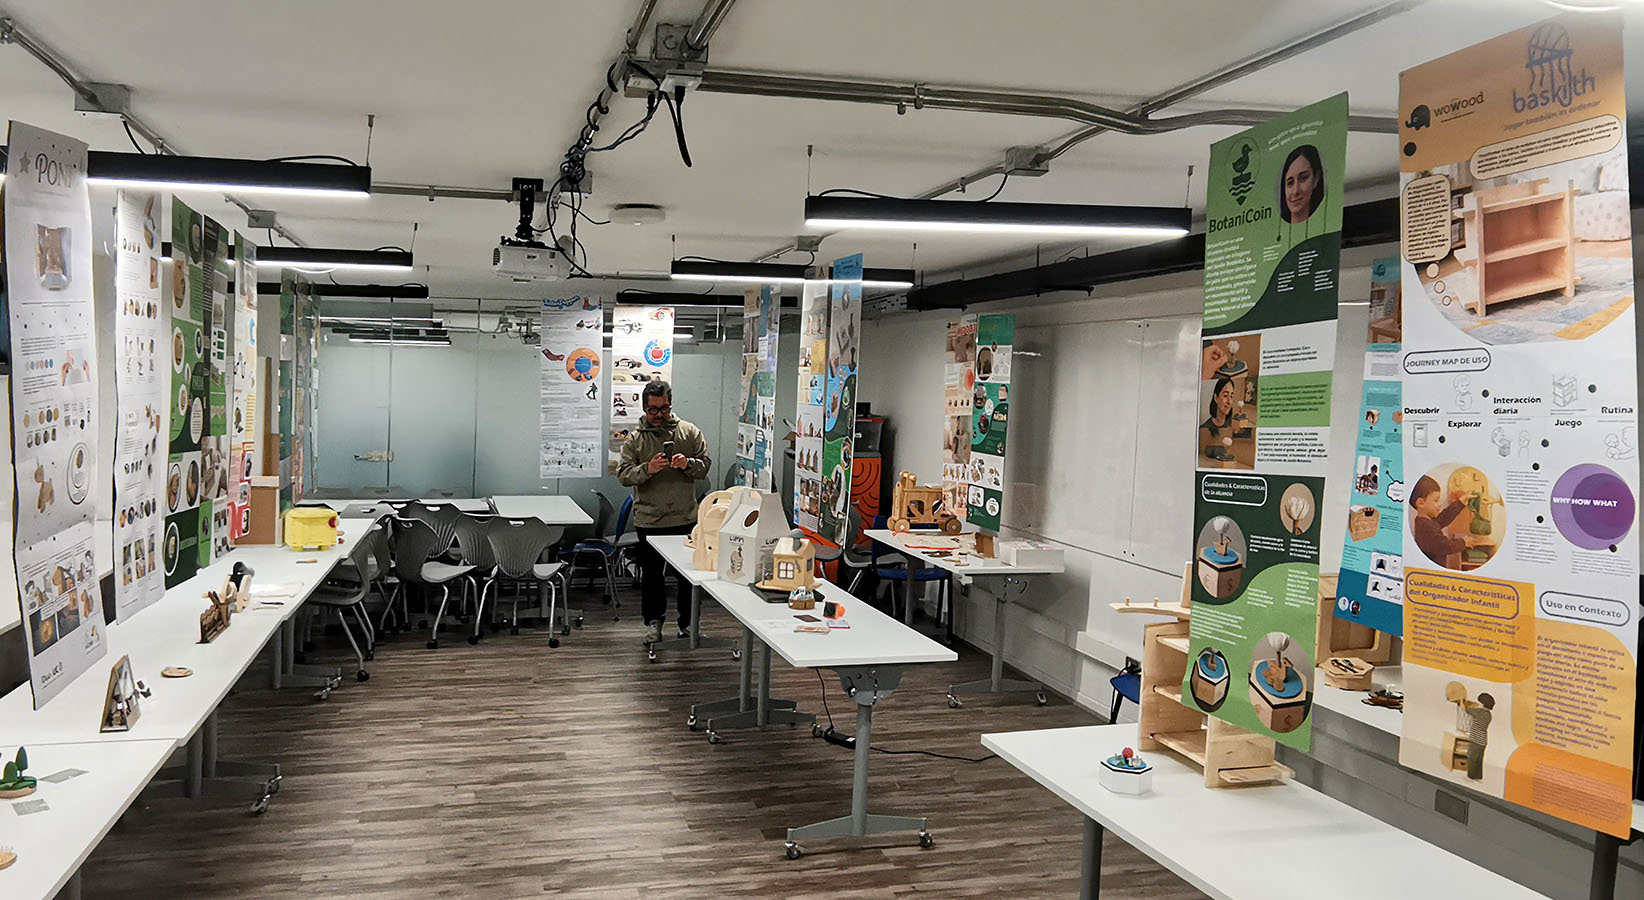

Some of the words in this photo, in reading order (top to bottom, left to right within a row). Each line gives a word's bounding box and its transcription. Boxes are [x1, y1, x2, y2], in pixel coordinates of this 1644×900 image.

[1433, 91, 1485, 117] wowood
[1209, 207, 1272, 233] BotaniCoin
[1406, 359, 1441, 368] JOURNEY
[1472, 356, 1488, 364] USO
[1494, 396, 1542, 405] Interacción
[1404, 407, 1440, 415] Descubrir
[1601, 405, 1634, 415] Rutina
[1494, 407, 1519, 415] diaria
[1448, 420, 1482, 429] Explorar
[1555, 418, 1583, 428] Juego
[1553, 496, 1570, 504] WHY
[1571, 497, 1592, 506] HOW
[1593, 499, 1618, 508] WHAT
[1408, 579, 1450, 591] Cualidades
[1421, 590, 1469, 603] Organizador
[1545, 600, 1563, 610] Uso
[1564, 604, 1577, 612] en
[1578, 604, 1623, 619] Contexto
